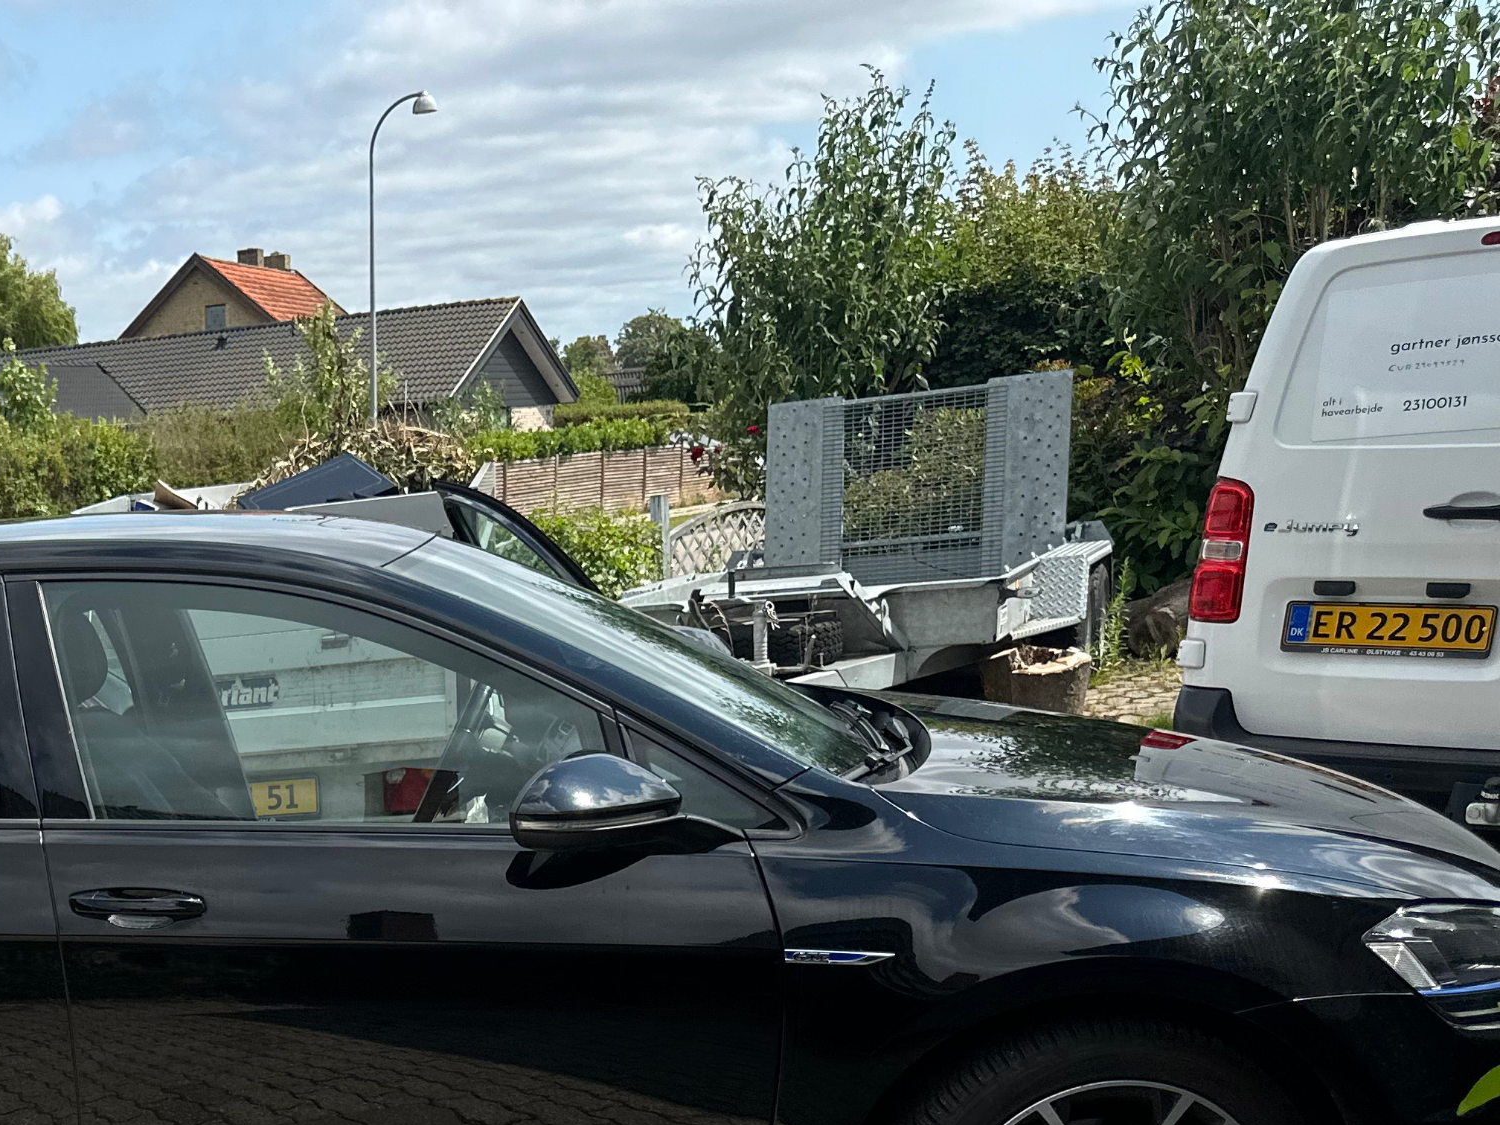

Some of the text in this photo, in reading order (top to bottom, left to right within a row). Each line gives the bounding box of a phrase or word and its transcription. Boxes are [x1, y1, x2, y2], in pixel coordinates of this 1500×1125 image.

[1391, 338, 1451, 355] gartner
[1322, 403, 1384, 417] havearbejde
[1323, 397, 1336, 407] alt
[1403, 396, 1468, 412] 23100131
[1290, 627, 1304, 636] DK
[1312, 611, 1486, 644] ER 22 500
[219, 677, 279, 707] riant
[268, 784, 299, 811] 51
